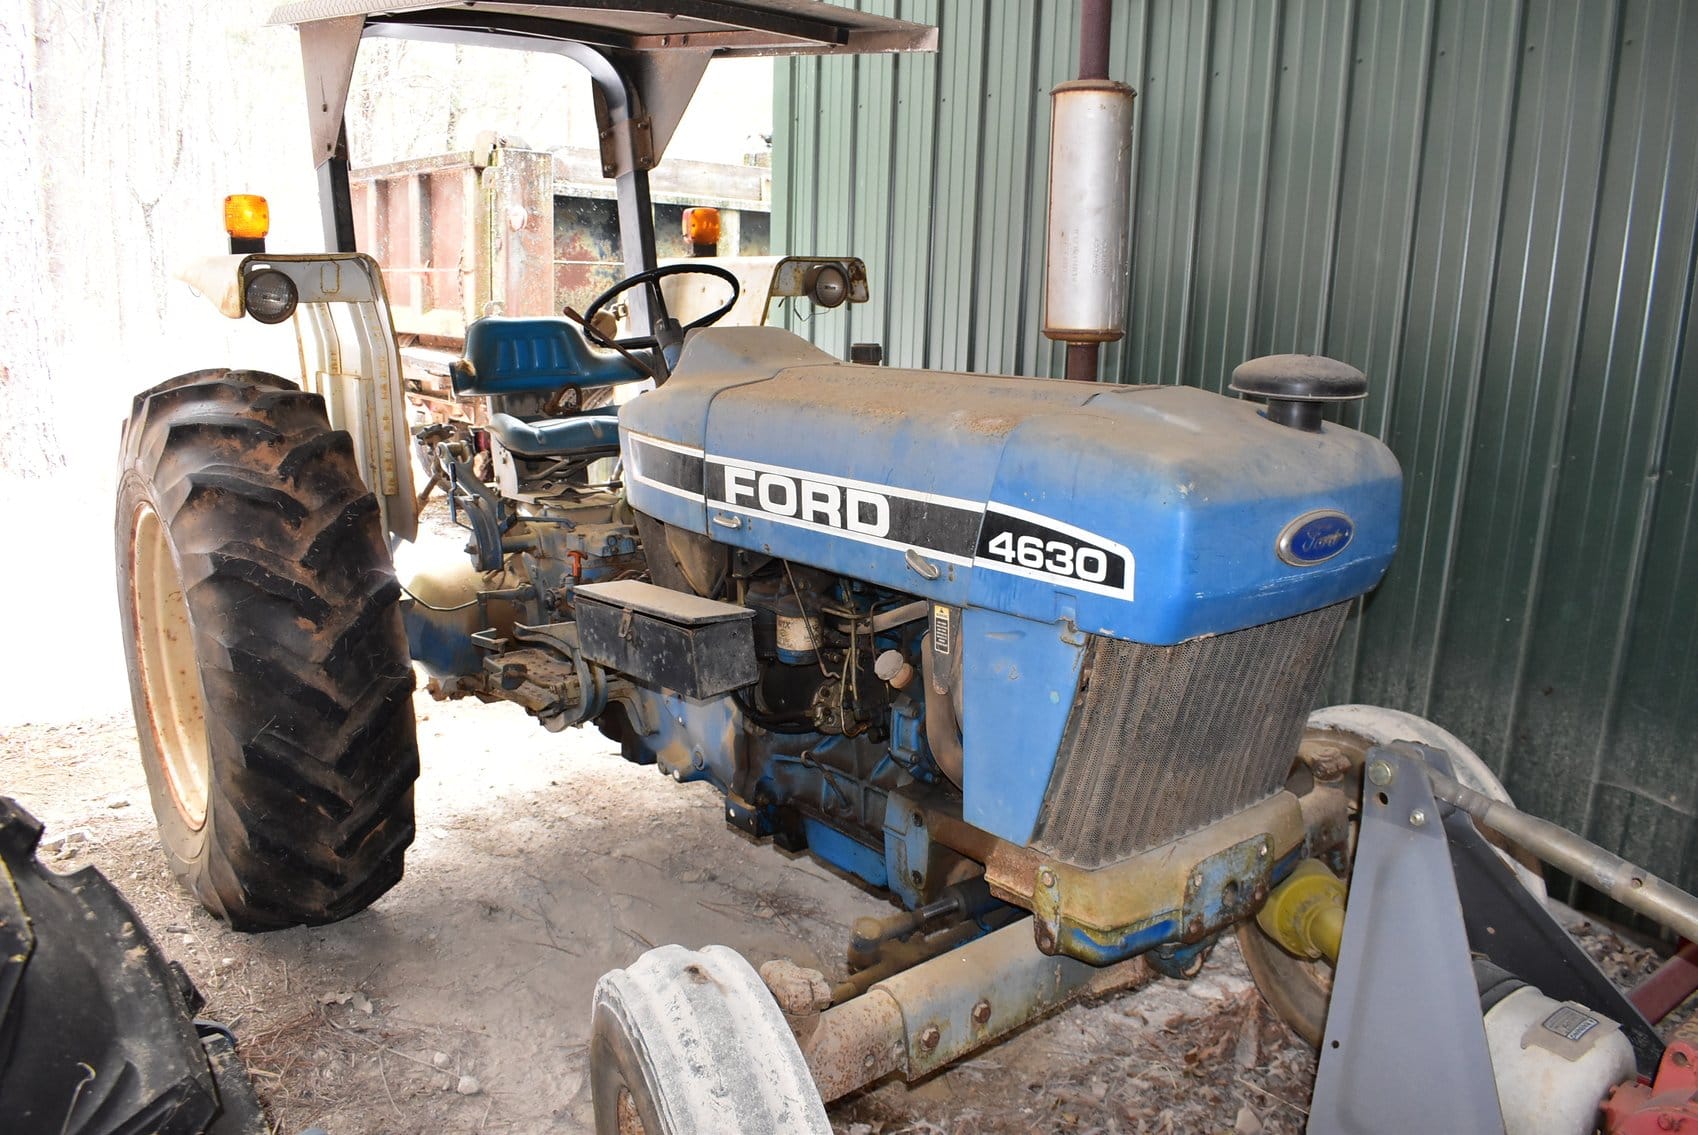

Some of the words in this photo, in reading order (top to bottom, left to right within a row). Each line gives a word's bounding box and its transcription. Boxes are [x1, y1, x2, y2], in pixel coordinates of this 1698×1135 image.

[723, 467, 890, 538] FORD
[988, 532, 1107, 583] 4630
[1302, 525, 1343, 551] Ford
